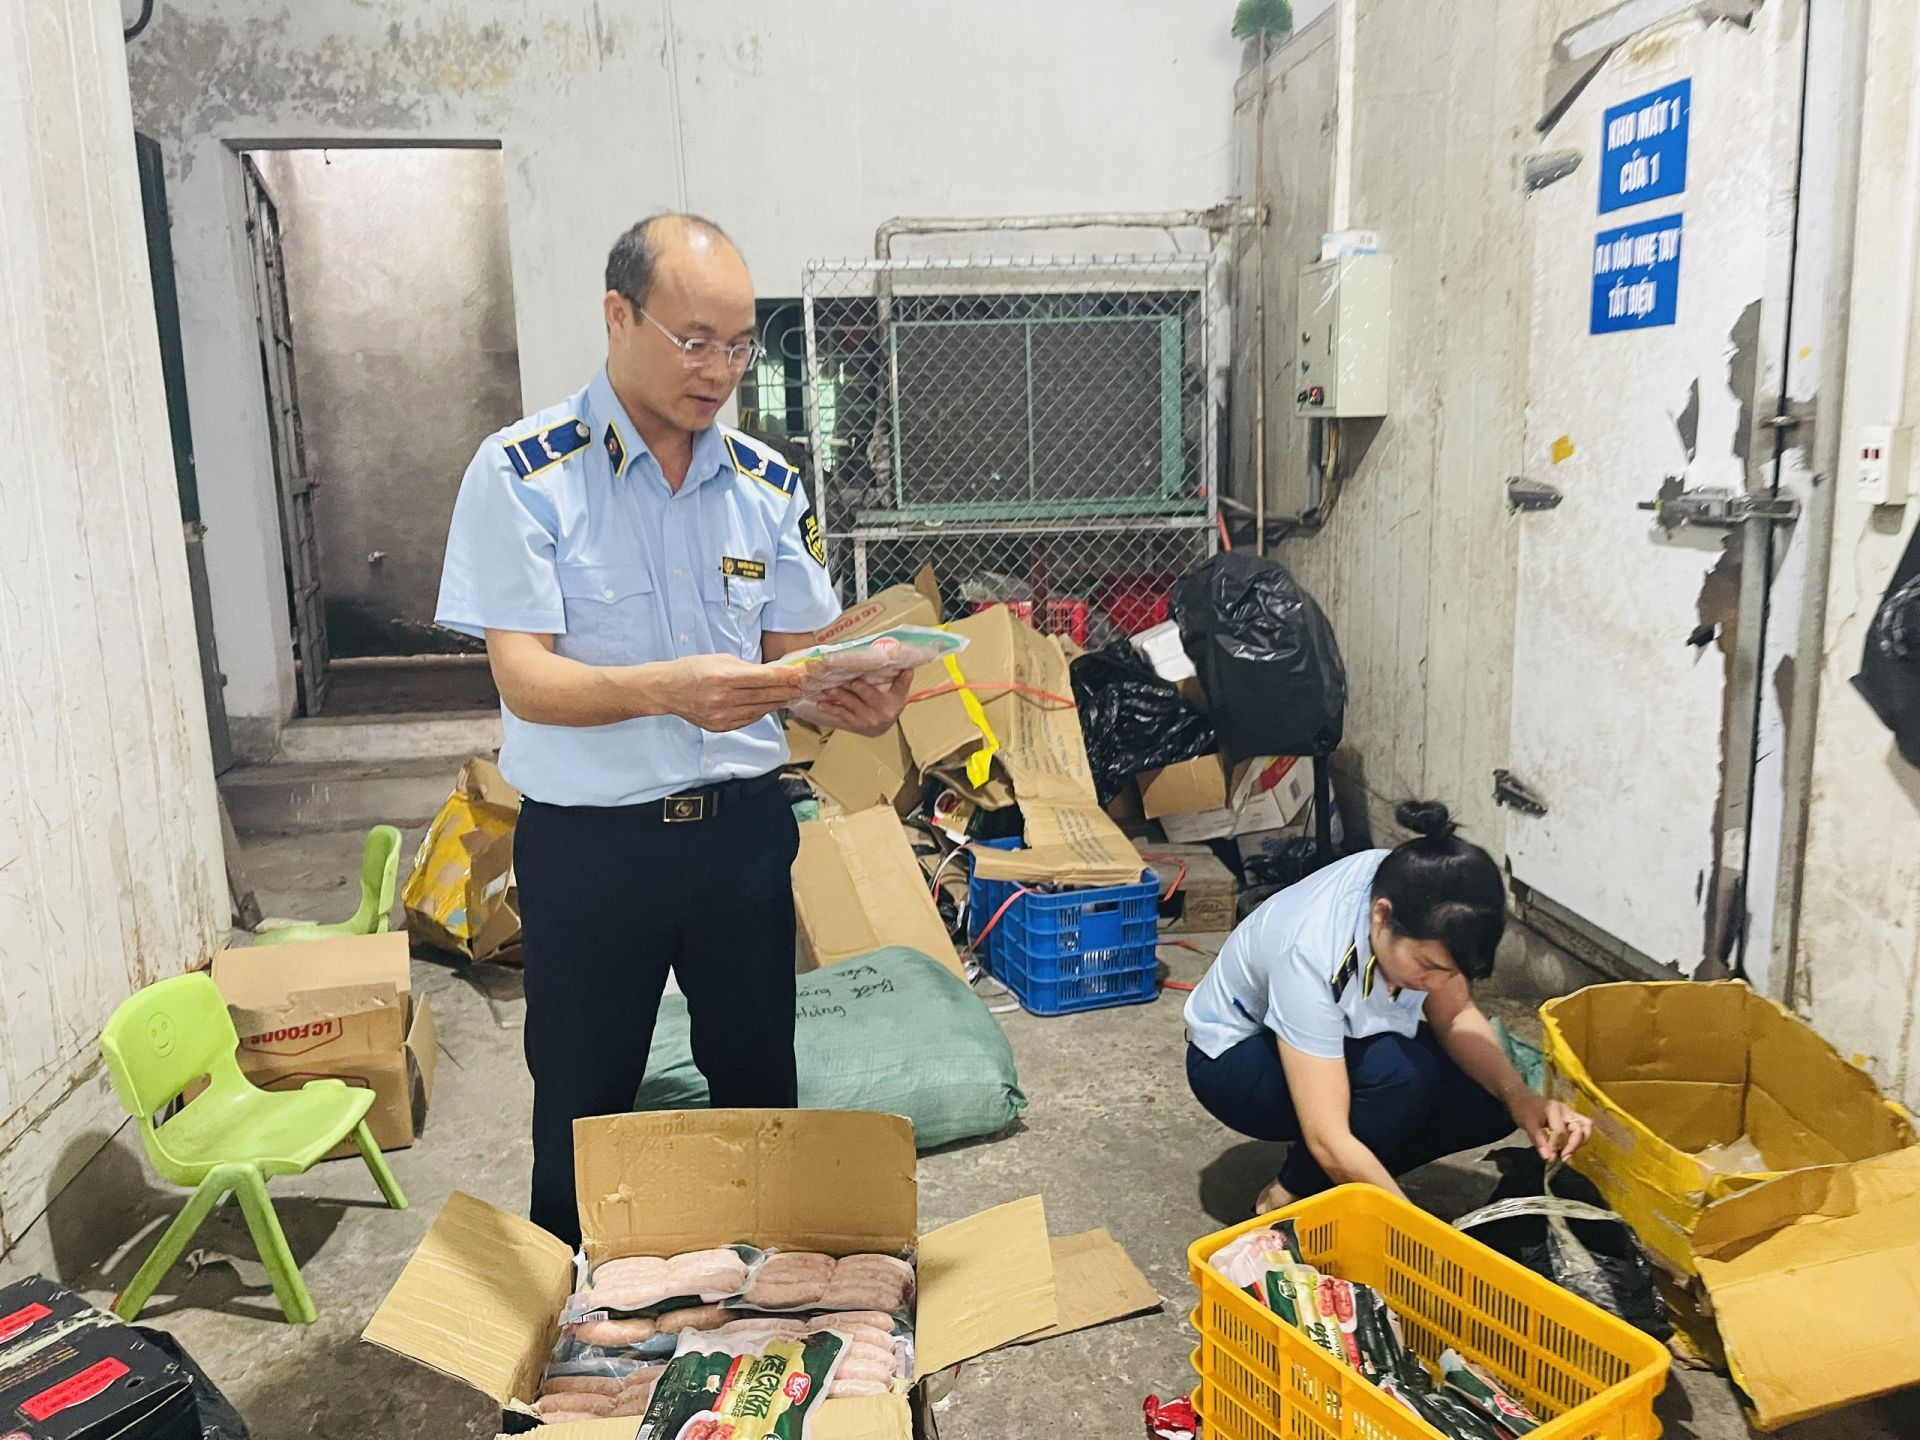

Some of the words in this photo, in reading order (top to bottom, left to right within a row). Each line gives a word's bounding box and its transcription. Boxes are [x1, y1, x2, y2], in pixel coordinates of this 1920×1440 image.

[1608, 112, 1636, 151] KHO
[1637, 97, 1670, 141] MÁT
[1671, 97, 1681, 130] 1
[1650, 153, 1660, 185] 1
[1595, 245, 1610, 275] RA
[312, 1021, 333, 1036] LC
